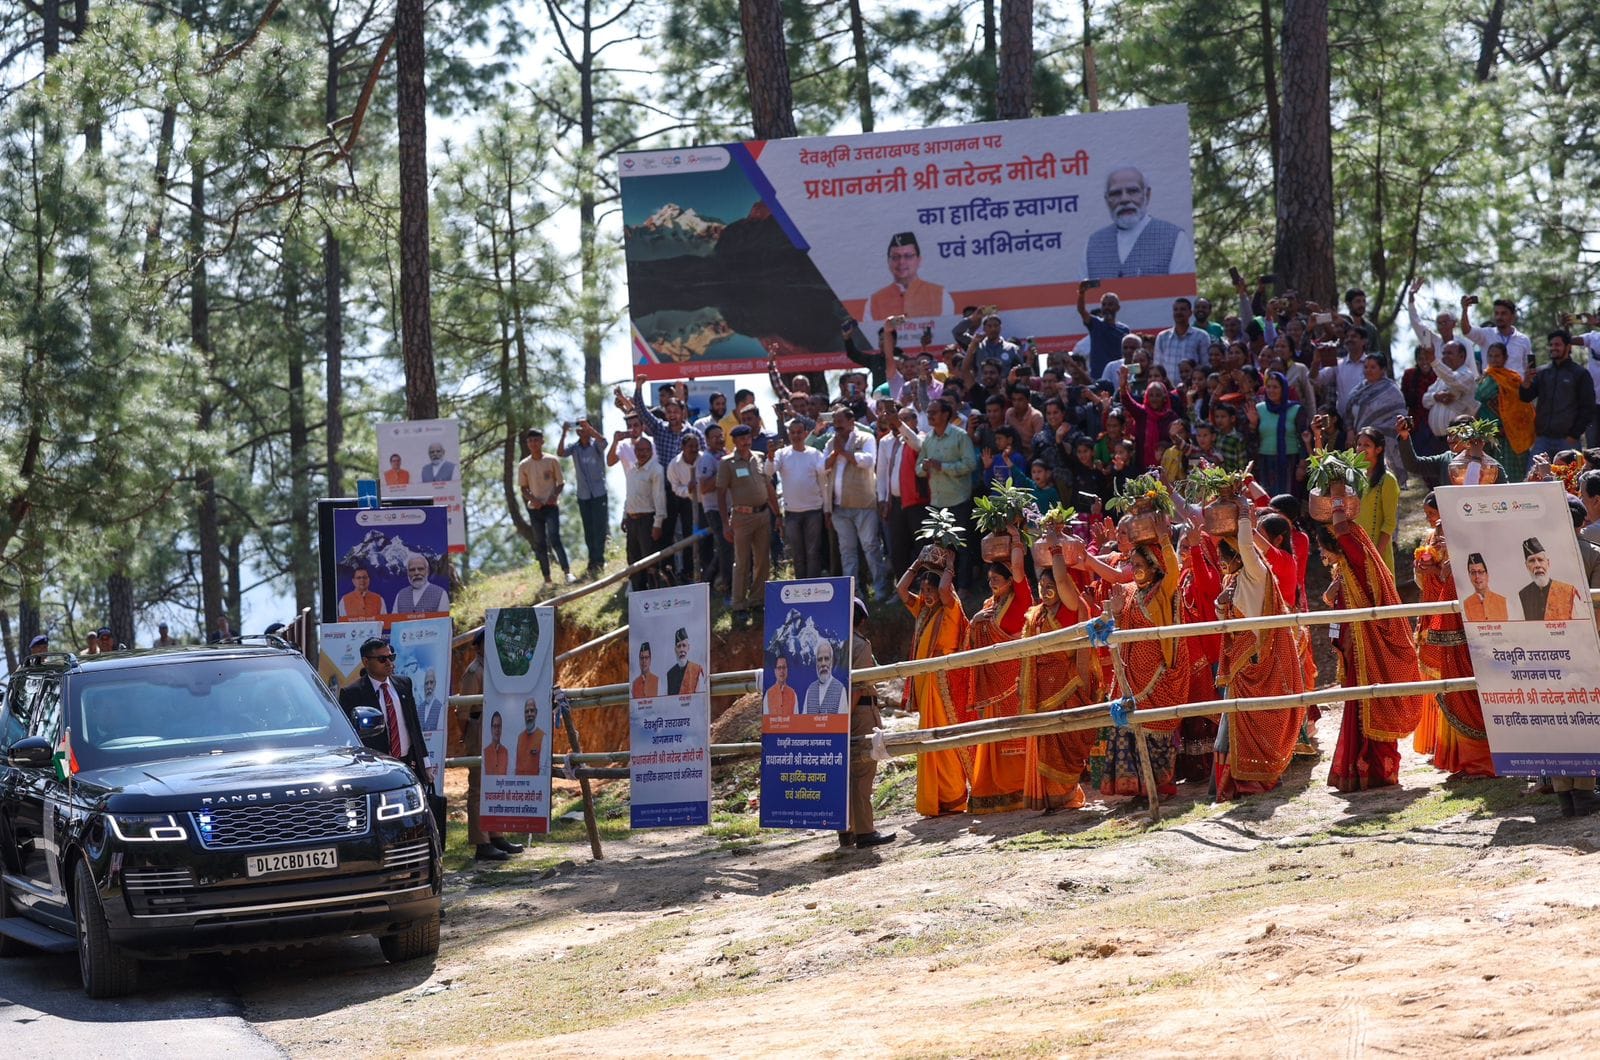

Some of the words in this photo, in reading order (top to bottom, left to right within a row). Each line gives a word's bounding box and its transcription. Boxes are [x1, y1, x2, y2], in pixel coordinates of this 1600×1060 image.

[800, 145, 850, 168] देवभूमि
[854, 141, 920, 161] उत्तराखण्ड
[924, 138, 980, 155] आगमन
[983, 134, 1002, 149] पर
[804, 166, 907, 200] प्रधानमंत्री
[912, 163, 939, 190] श्री
[943, 160, 1002, 187] नरेन्द्र
[1006, 152, 1056, 182] मोदी
[1060, 149, 1089, 176] जी
[917, 206, 945, 226] का
[949, 196, 1010, 226] हार्दिक
[1012, 194, 1079, 218] स्वागत
[938, 237, 966, 258] एवं
[971, 228, 1062, 257] अभिनंदन
[1493, 647, 1526, 665] देवभूमि
[1527, 650, 1571, 660] उत्तराखण्ड
[1511, 670, 1547, 680] आगमन
[1548, 670, 1562, 680] पर
[1481, 688, 1525, 704] प्रधानमंत्री
[1527, 688, 1538, 704] श्री
[1539, 688, 1566, 705] नरेन्द्र
[1566, 688, 1588, 704] मोदी
[644, 717, 664, 732] देवभूमि
[664, 718, 690, 728] उत्तराखण्ड
[1493, 714, 1504, 726] का
[1504, 712, 1528, 726] हार्दिक
[1529, 714, 1556, 726] स्वागत
[1556, 712, 1568, 726] एवं
[1569, 711, 1600, 726] अभिनंद
[652, 735, 674, 744] आगमन
[674, 734, 682, 743] पर
[631, 751, 658, 766] प्रधानमंत्री
[658, 750, 666, 764] श्री
[766, 752, 793, 766] प्रधानमंत्री
[794, 752, 802, 766] श्री
[802, 752, 819, 766] नरेन्द्र
[820, 752, 833, 766] मोदी
[834, 752, 843, 766] जी
[780, 772, 788, 782] का
[789, 770, 807, 783] हार्दिक
[807, 772, 826, 782] स्वागत
[202, 792, 272, 804] RANGE
[286, 784, 352, 796] ROVER
[785, 788, 793, 800] एवं
[795, 787, 820, 801] अभिनंदन
[256, 851, 336, 872] DL2CBD1621
